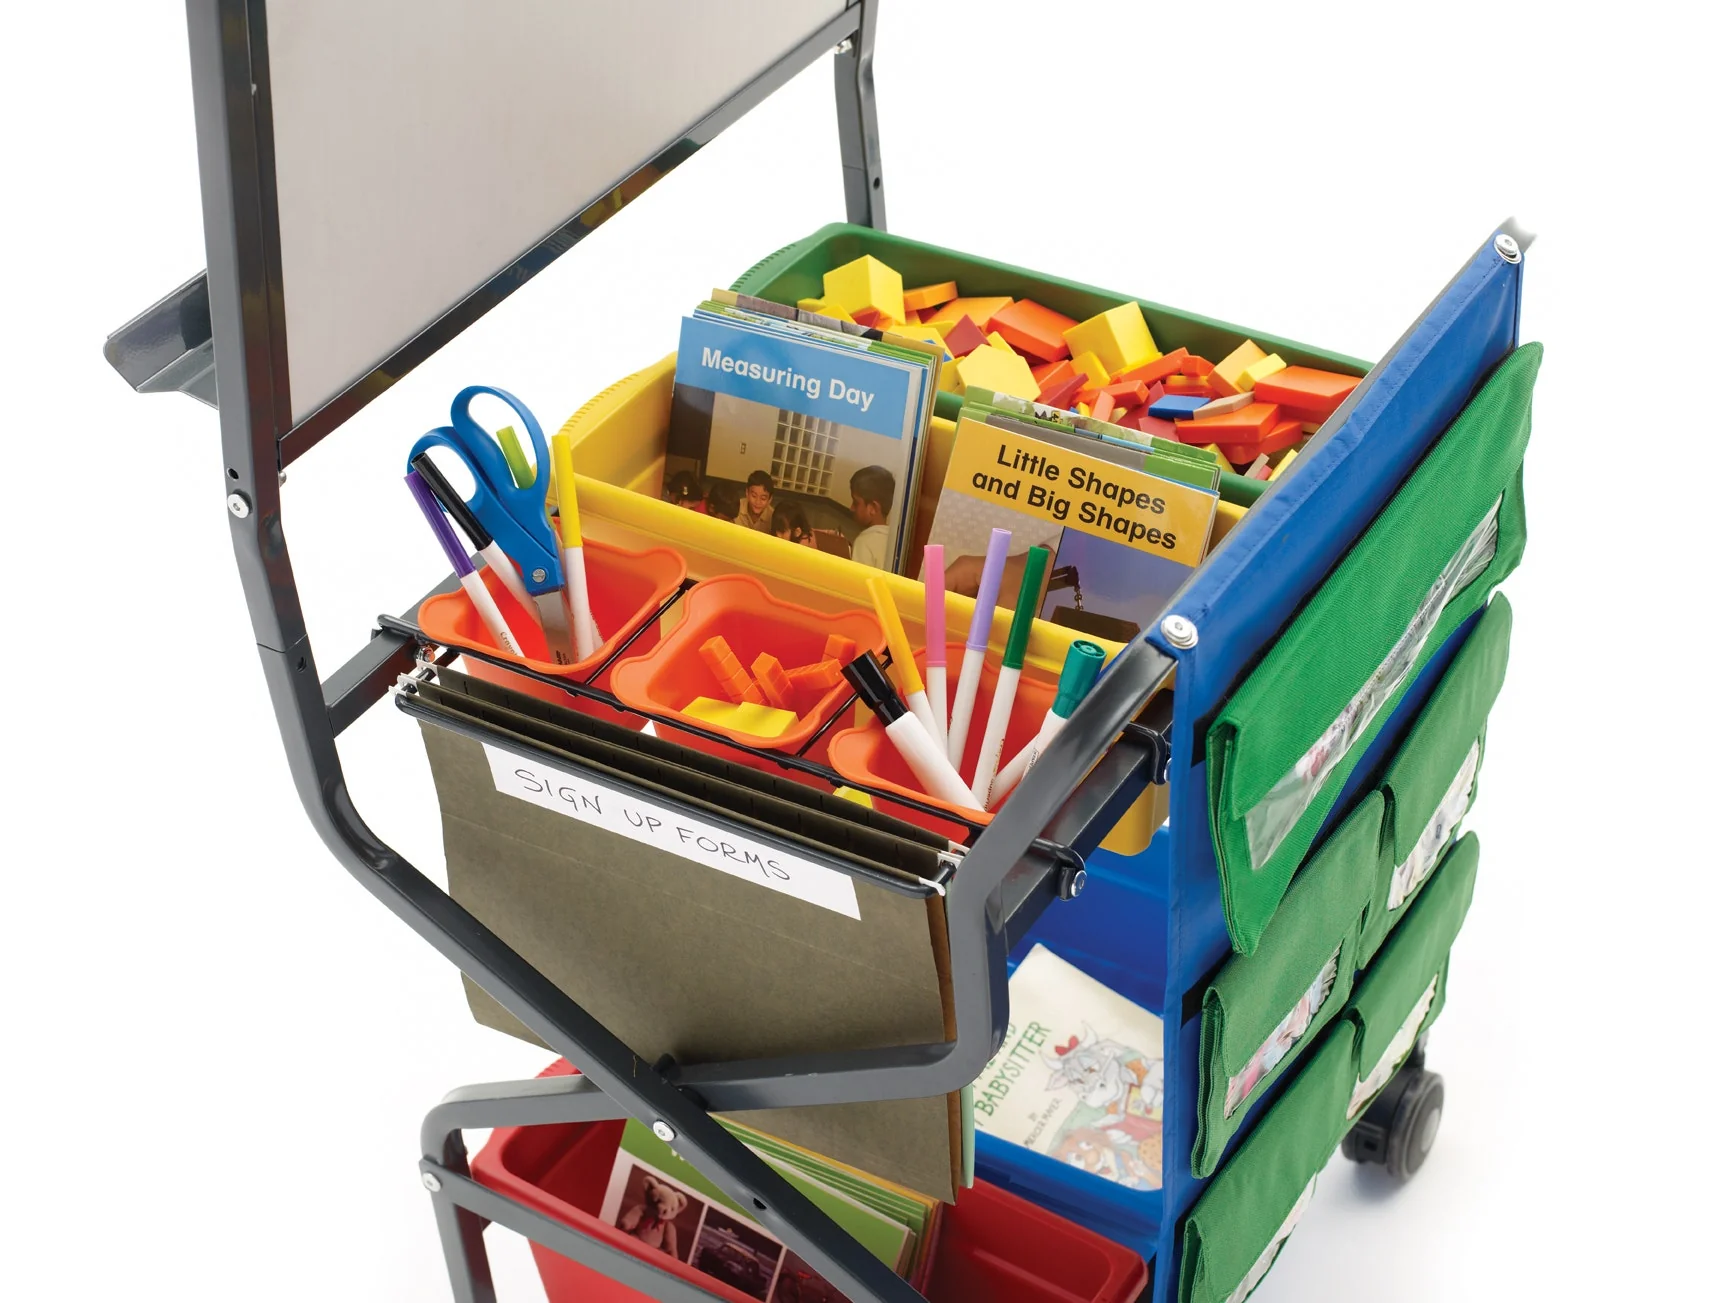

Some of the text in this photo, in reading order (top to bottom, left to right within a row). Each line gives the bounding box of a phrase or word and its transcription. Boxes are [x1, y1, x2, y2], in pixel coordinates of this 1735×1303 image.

[702, 347, 875, 412] Measuring Day
[972, 472, 1177, 550] and Big Shapes
[997, 444, 1166, 515] Little Shapes
[514, 768, 791, 881] SIGN UP FORMS
[974, 1021, 1052, 1117] BABYSITTER
